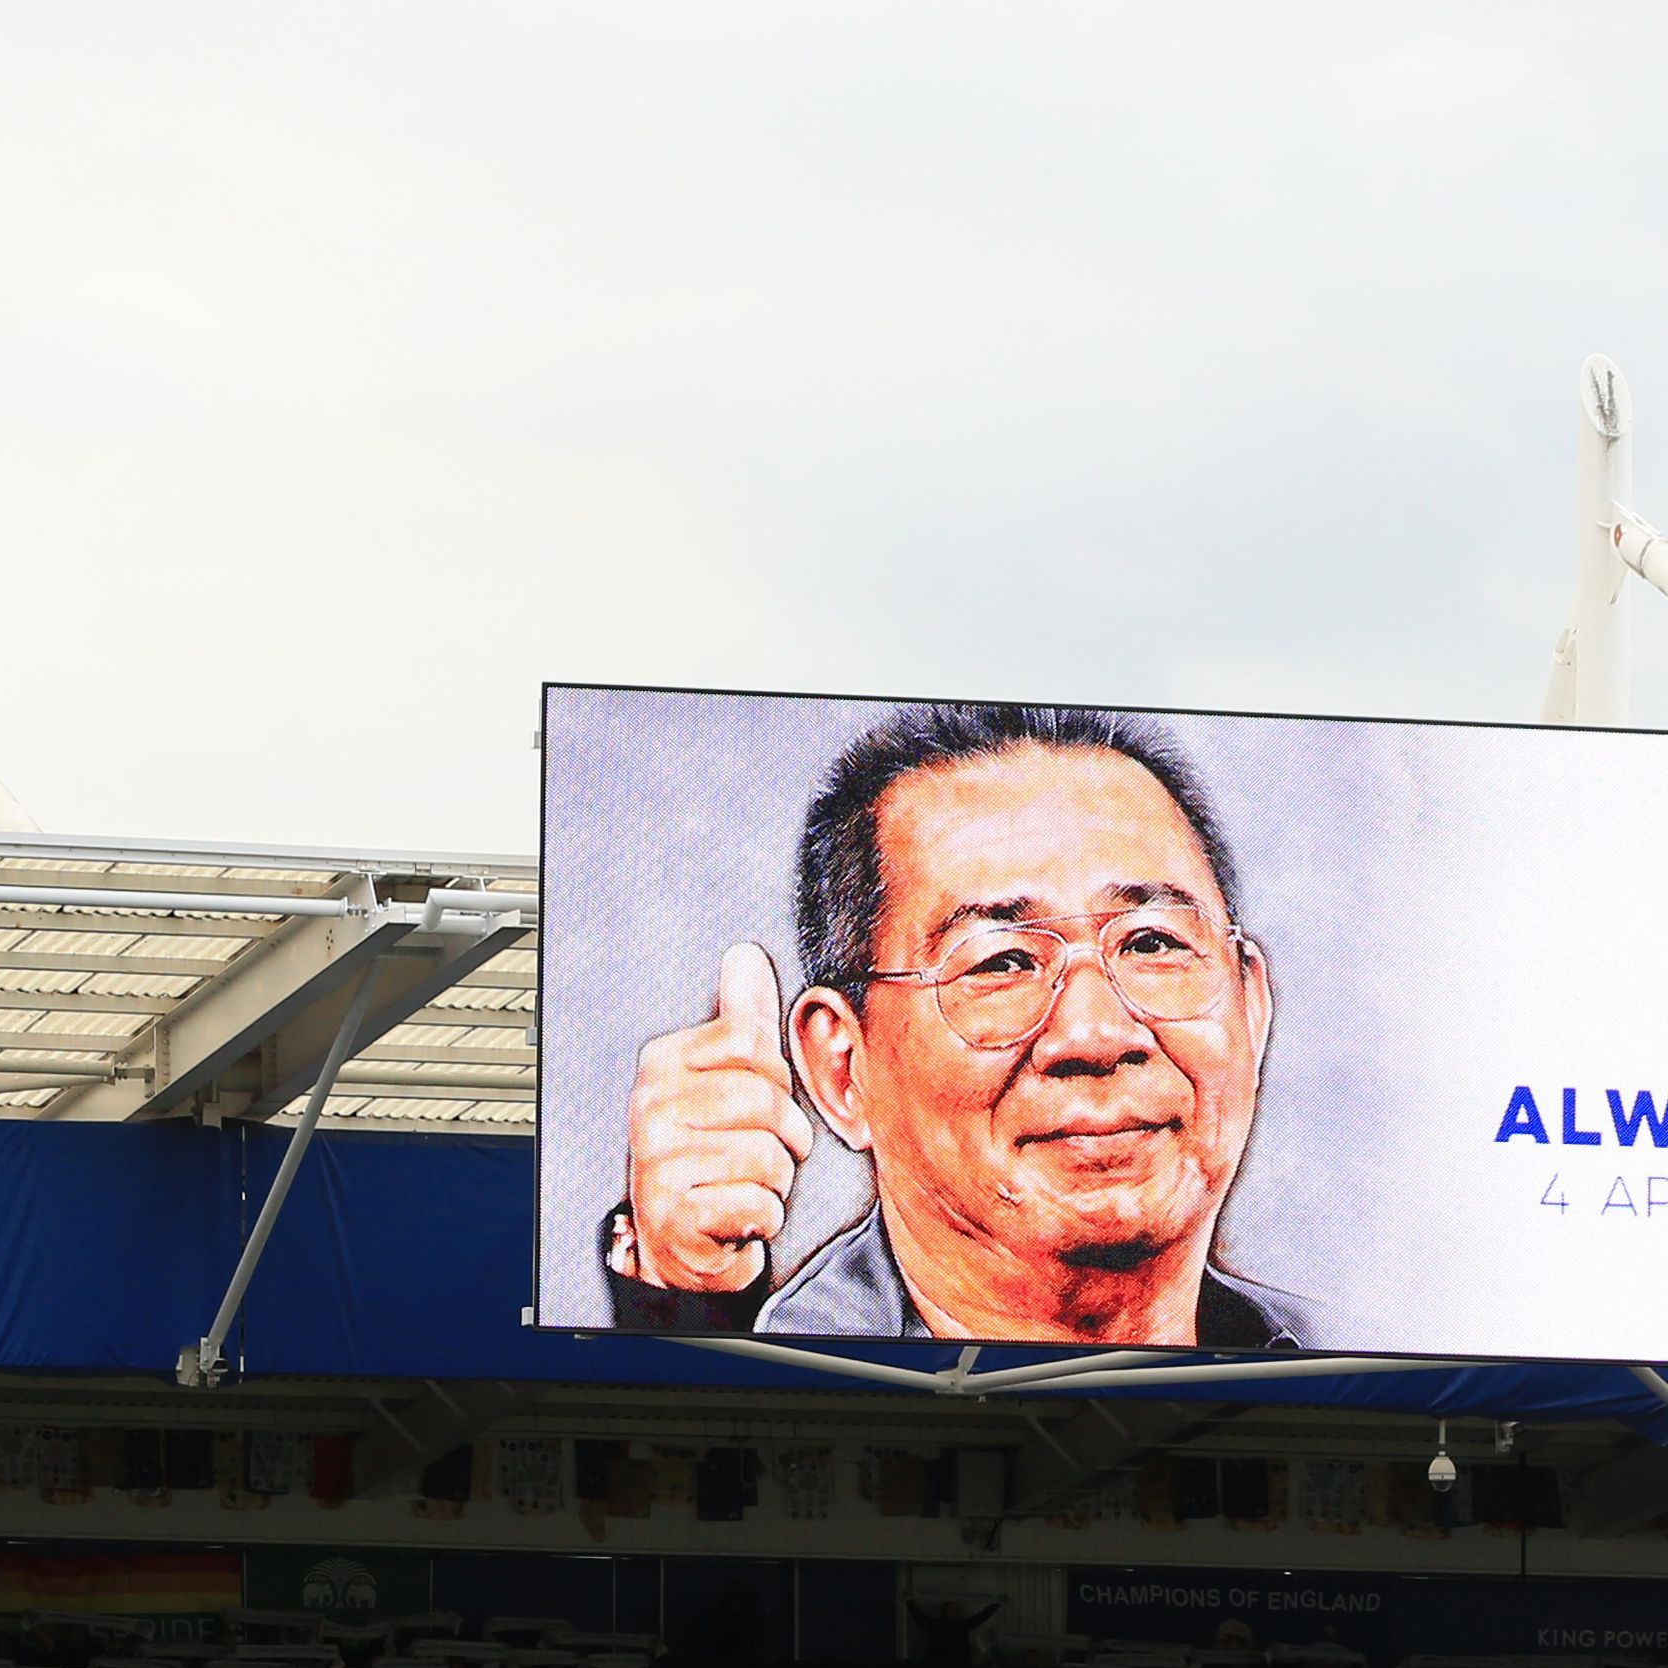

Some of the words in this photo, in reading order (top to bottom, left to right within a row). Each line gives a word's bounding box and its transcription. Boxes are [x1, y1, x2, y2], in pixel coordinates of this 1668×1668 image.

[1540, 1173, 1570, 1215] 4
[1080, 1583, 1221, 1608] CHAMPIONS
[1228, 1587, 1260, 1609] OF
[1268, 1589, 1382, 1612] ENGLAND
[1537, 1628, 1596, 1648] KING
